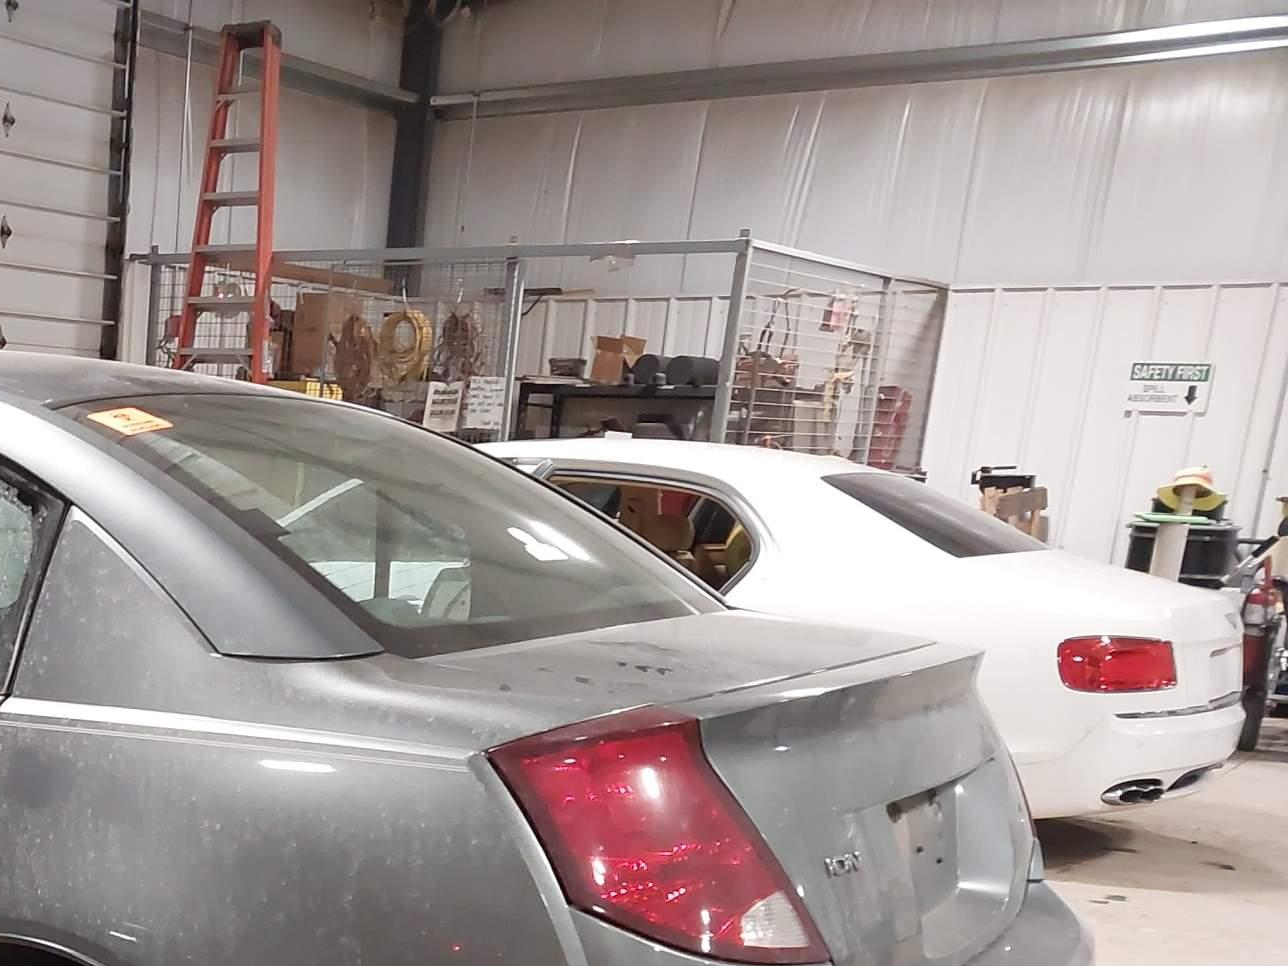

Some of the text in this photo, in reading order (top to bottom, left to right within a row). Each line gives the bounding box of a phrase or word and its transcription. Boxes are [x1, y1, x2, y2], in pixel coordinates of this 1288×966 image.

[1133, 364, 1209, 381] SAFETY FIRST
[824, 851, 862, 880] ION
